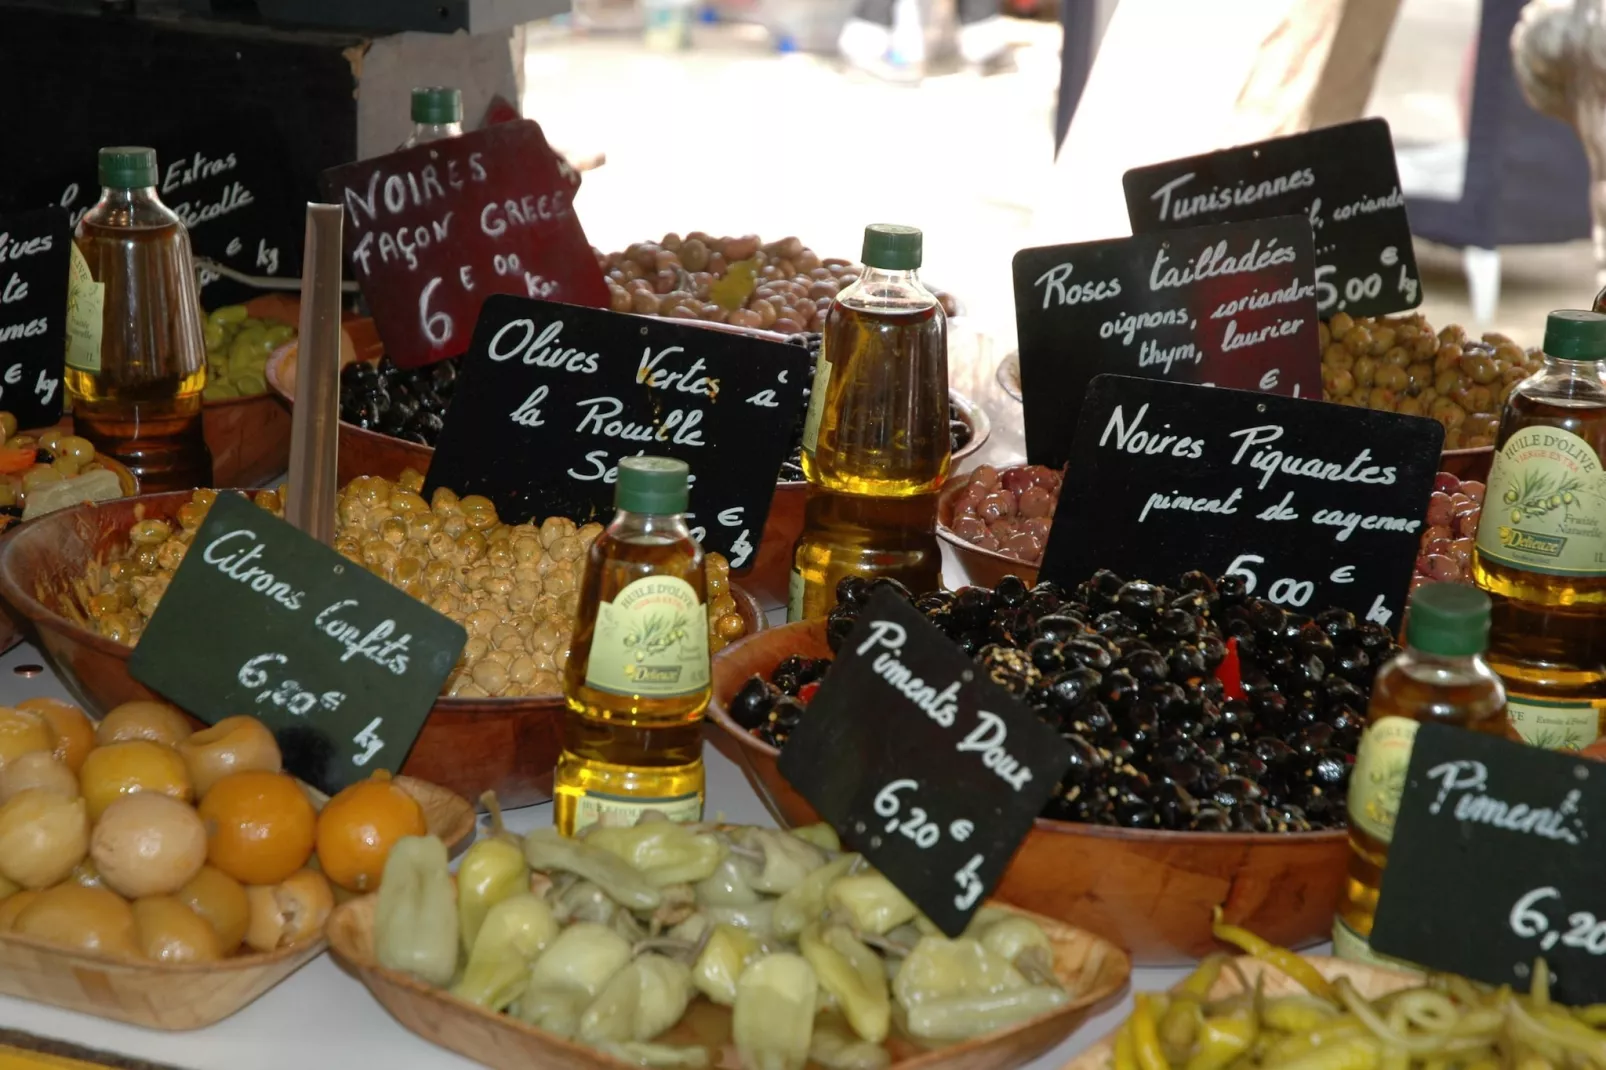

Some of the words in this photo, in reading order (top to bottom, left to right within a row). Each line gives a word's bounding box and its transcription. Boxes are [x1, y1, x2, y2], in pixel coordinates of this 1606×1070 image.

[162, 152, 238, 194] Extras
[344, 153, 488, 228] NOIRES
[1150, 166, 1317, 222] Tunisiennes
[256, 238, 279, 275] kg
[353, 212, 455, 275] FAÇON
[1034, 262, 1122, 310] Roses
[1149, 238, 1297, 292] tailladées
[418, 276, 453, 345] 6
[1314, 264, 1383, 311] 5,00
[1398, 263, 1418, 304] kg
[1099, 307, 1198, 346] oignons,
[1138, 338, 1203, 375] thym,
[1220, 320, 1305, 352] laurier
[488, 318, 599, 374] Olives
[635, 346, 720, 396] Vertes
[746, 369, 789, 408] à
[509, 385, 546, 427] la
[576, 396, 706, 447] Rouille
[1099, 402, 1205, 459] Noires
[1229, 425, 1397, 490] Piquantes
[1505, 434, 1541, 460] HUILE
[1544, 435, 1596, 473] D'OLIVE
[1138, 486, 1243, 523] piment
[1256, 490, 1299, 521] de
[1311, 505, 1422, 542] cayenne
[202, 529, 306, 611] Citrons
[314, 599, 413, 676] Confits
[856, 620, 962, 728] Piments
[873, 778, 941, 848] 6,20
